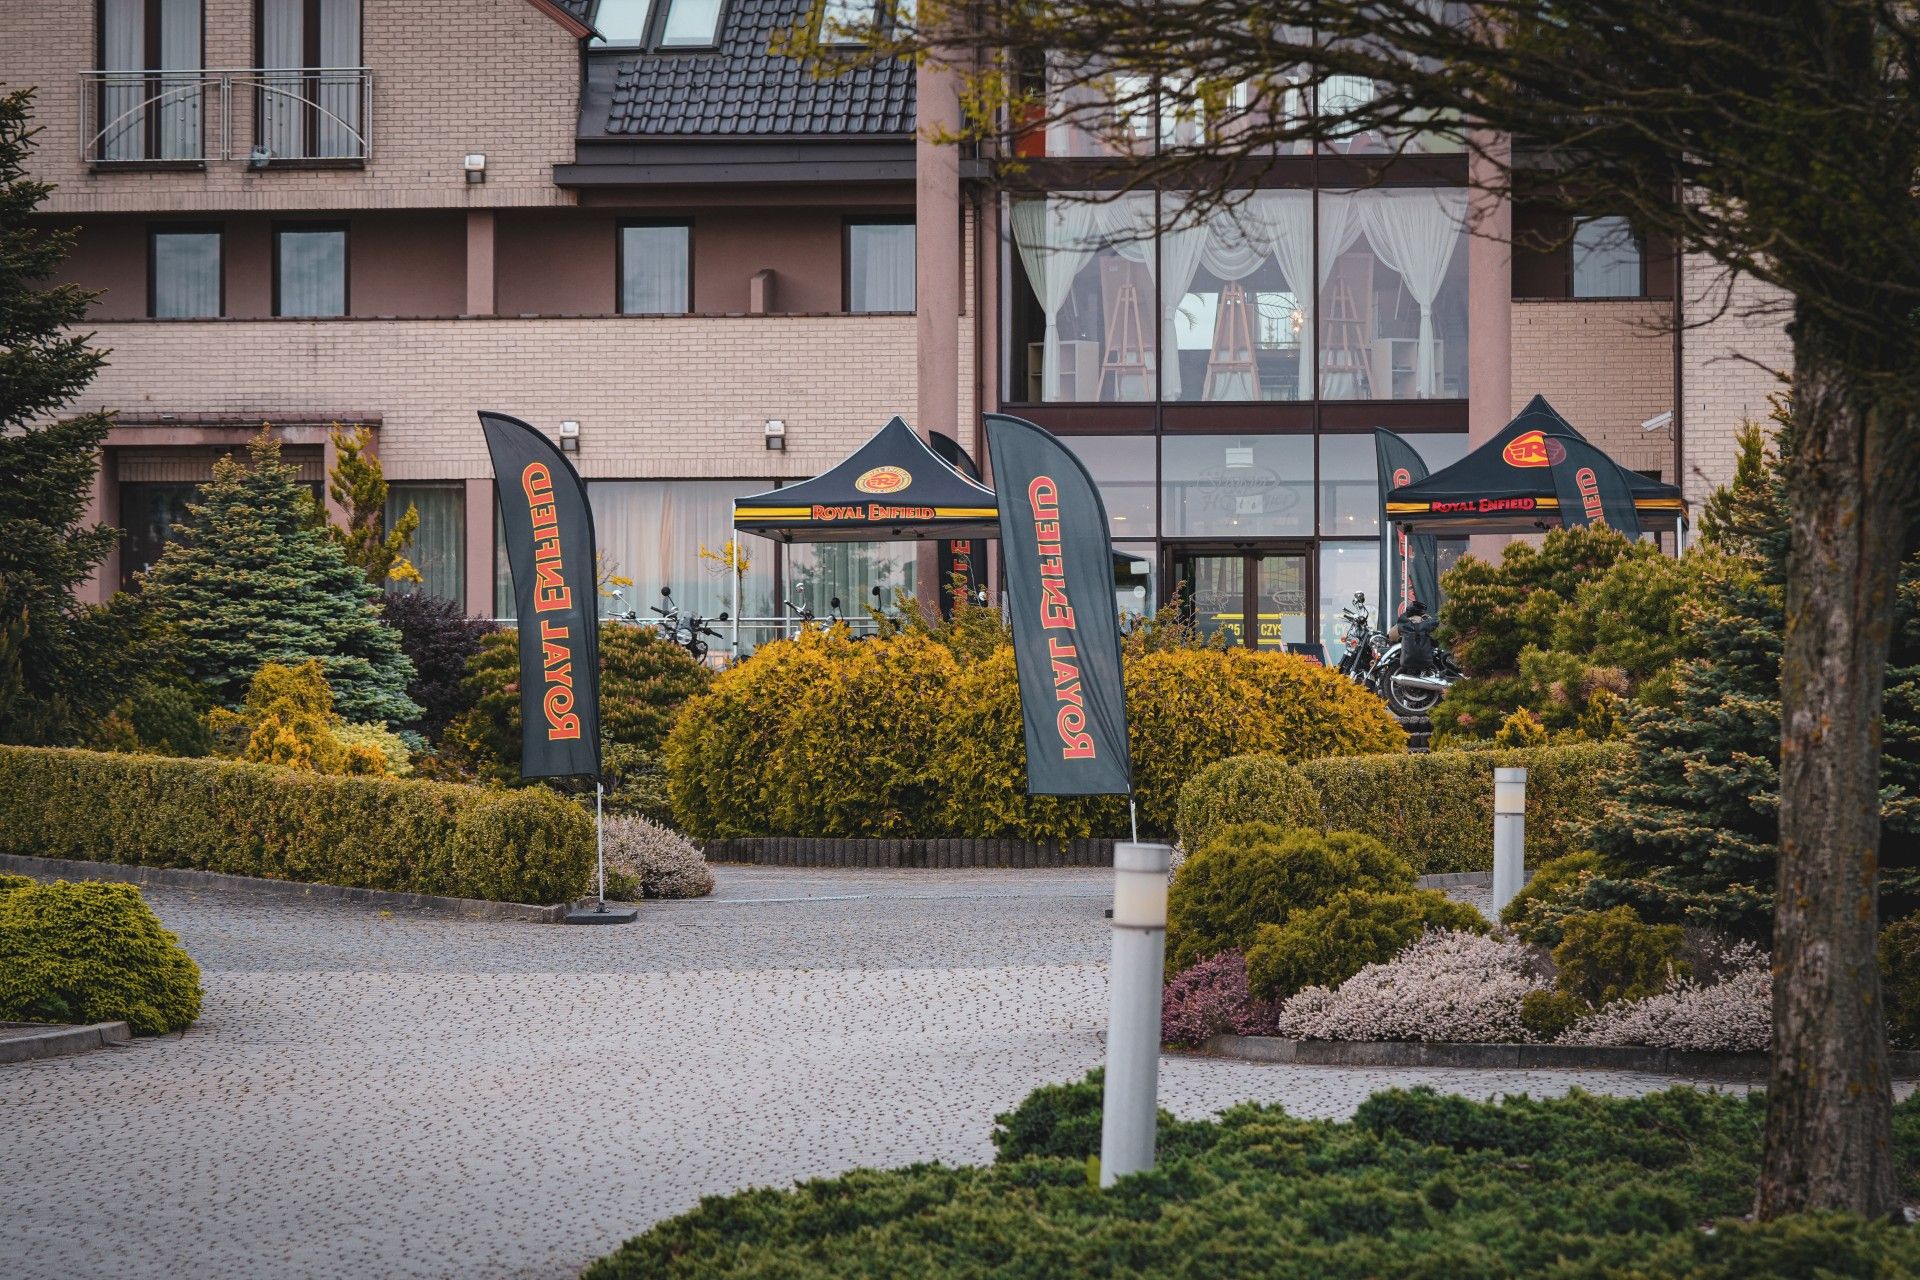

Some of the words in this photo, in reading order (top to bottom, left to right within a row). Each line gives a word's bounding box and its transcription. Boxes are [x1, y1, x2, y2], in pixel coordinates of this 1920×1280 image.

[812, 504, 866, 521] ROYAL
[868, 503, 936, 521] ENFIELD
[1431, 501, 1476, 513] ROYAL
[1479, 498, 1535, 513] ENFIELD
